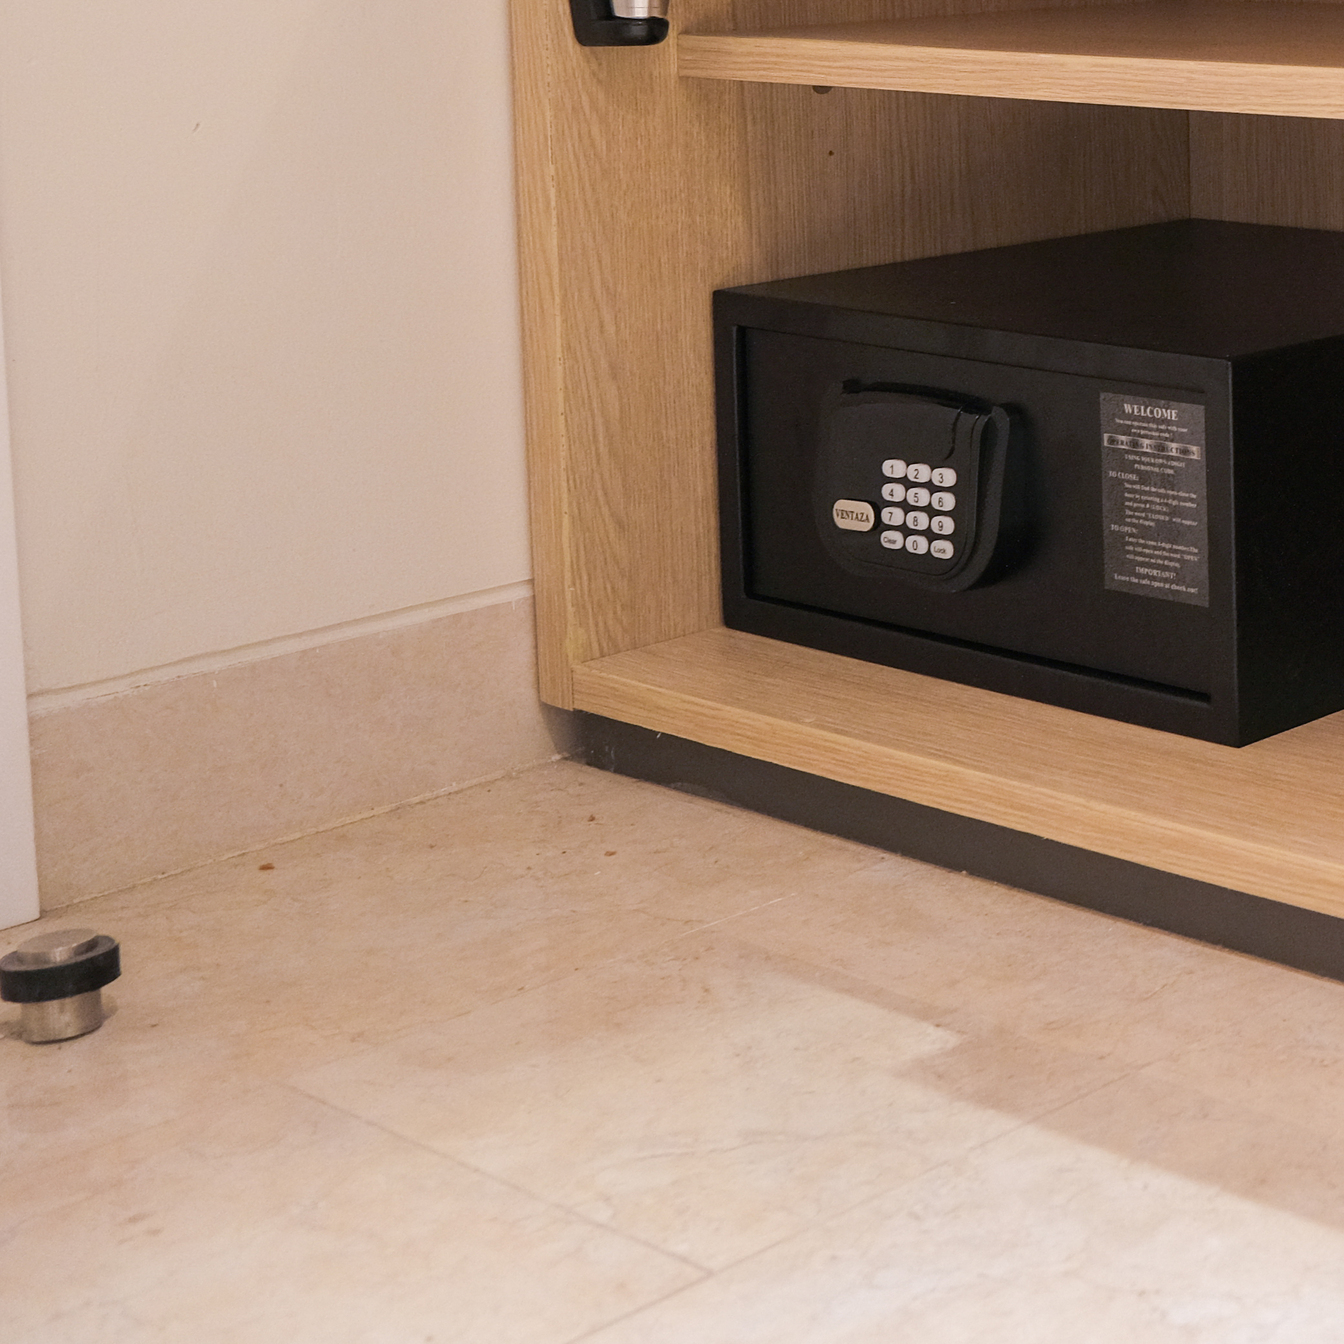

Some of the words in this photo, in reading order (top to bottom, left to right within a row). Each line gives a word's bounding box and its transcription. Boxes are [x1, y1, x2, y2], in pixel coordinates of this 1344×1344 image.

[1124, 403, 1178, 420] WELCOME
[889, 464, 894, 475] 1
[914, 468, 919, 479] 2
[938, 473, 944, 484] 3
[888, 488, 894, 498] 4
[914, 493, 919, 503] 5
[938, 497, 943, 508] 6
[835, 508, 870, 523] VENTAZA
[888, 512, 893, 522] 7
[913, 516, 918, 527] 8
[938, 521, 943, 531] 9
[883, 536, 897, 545] Clear
[912, 540, 918, 551] 0
[934, 546, 947, 555] Lock
